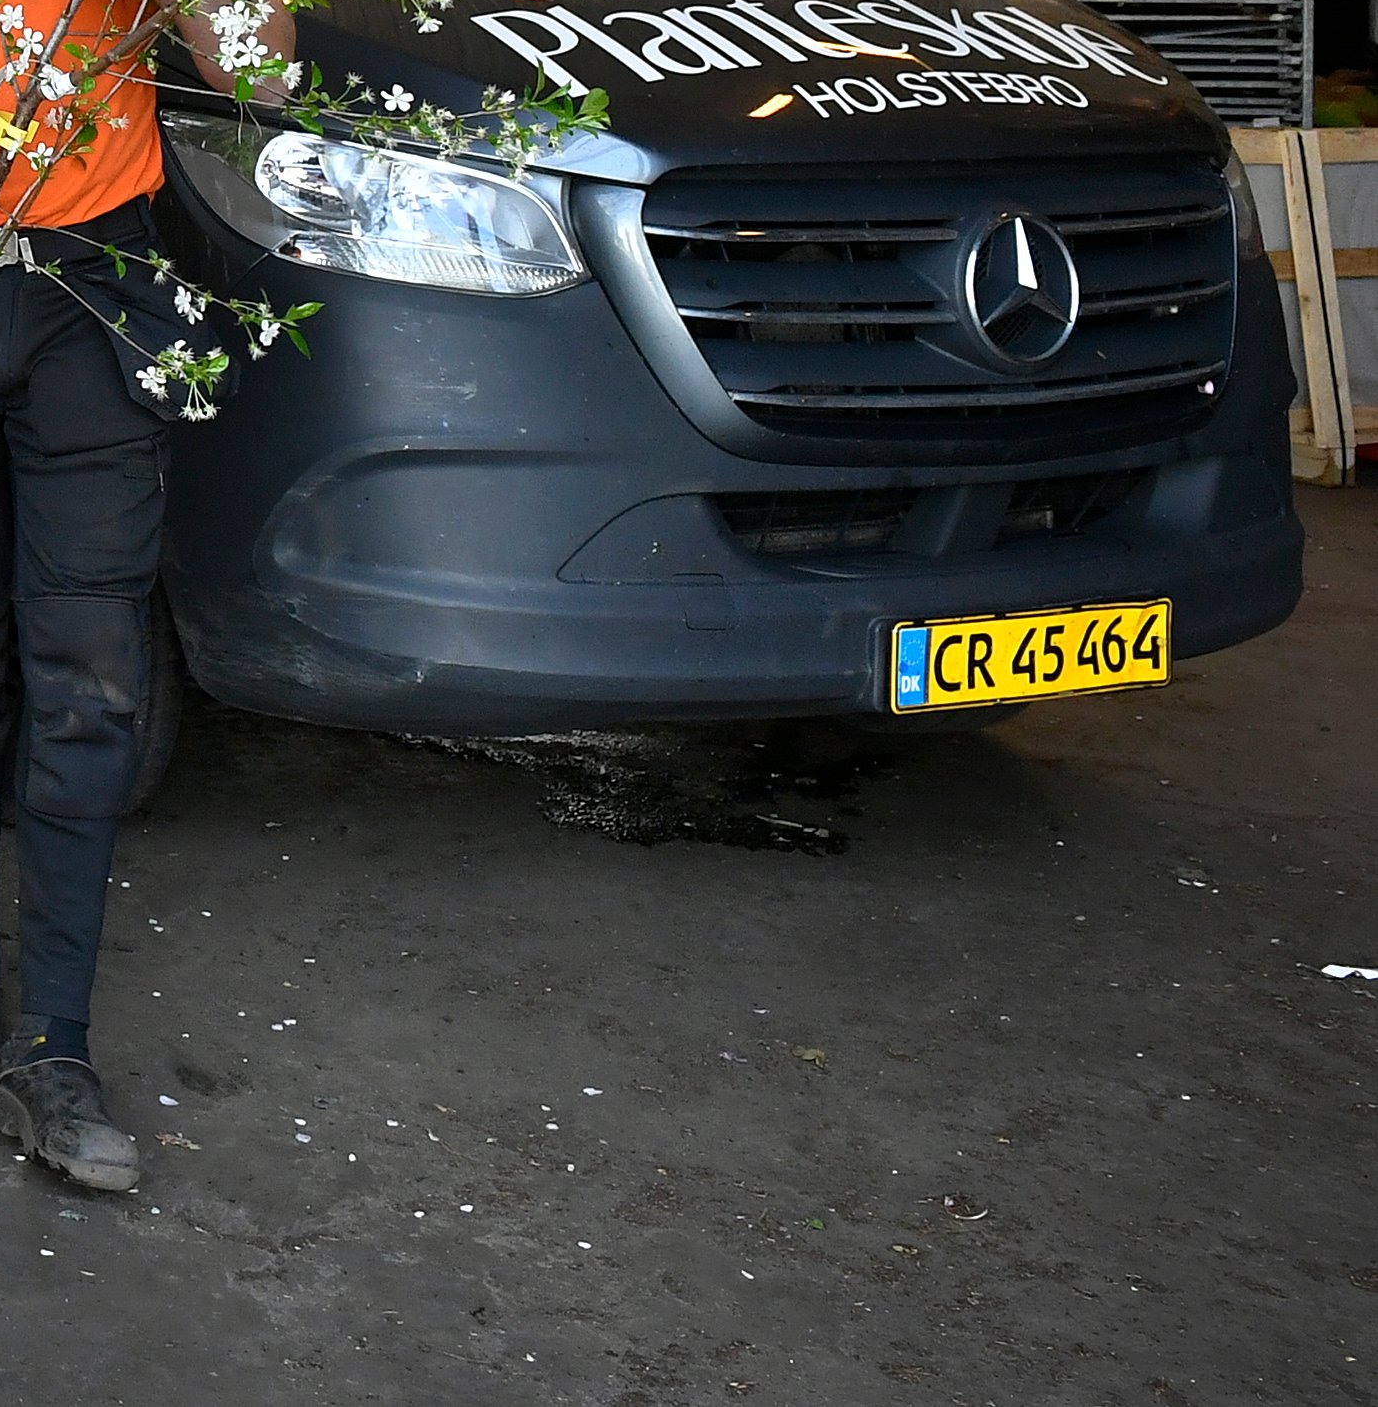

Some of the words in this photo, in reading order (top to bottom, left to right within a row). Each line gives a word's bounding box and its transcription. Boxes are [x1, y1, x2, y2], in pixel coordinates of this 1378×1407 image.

[794, 71, 1089, 119] HOLSTEBRO
[934, 633, 995, 692] CR
[1011, 625, 1065, 684] 45
[1077, 613, 1161, 676] 464
[901, 675, 920, 693] DK
